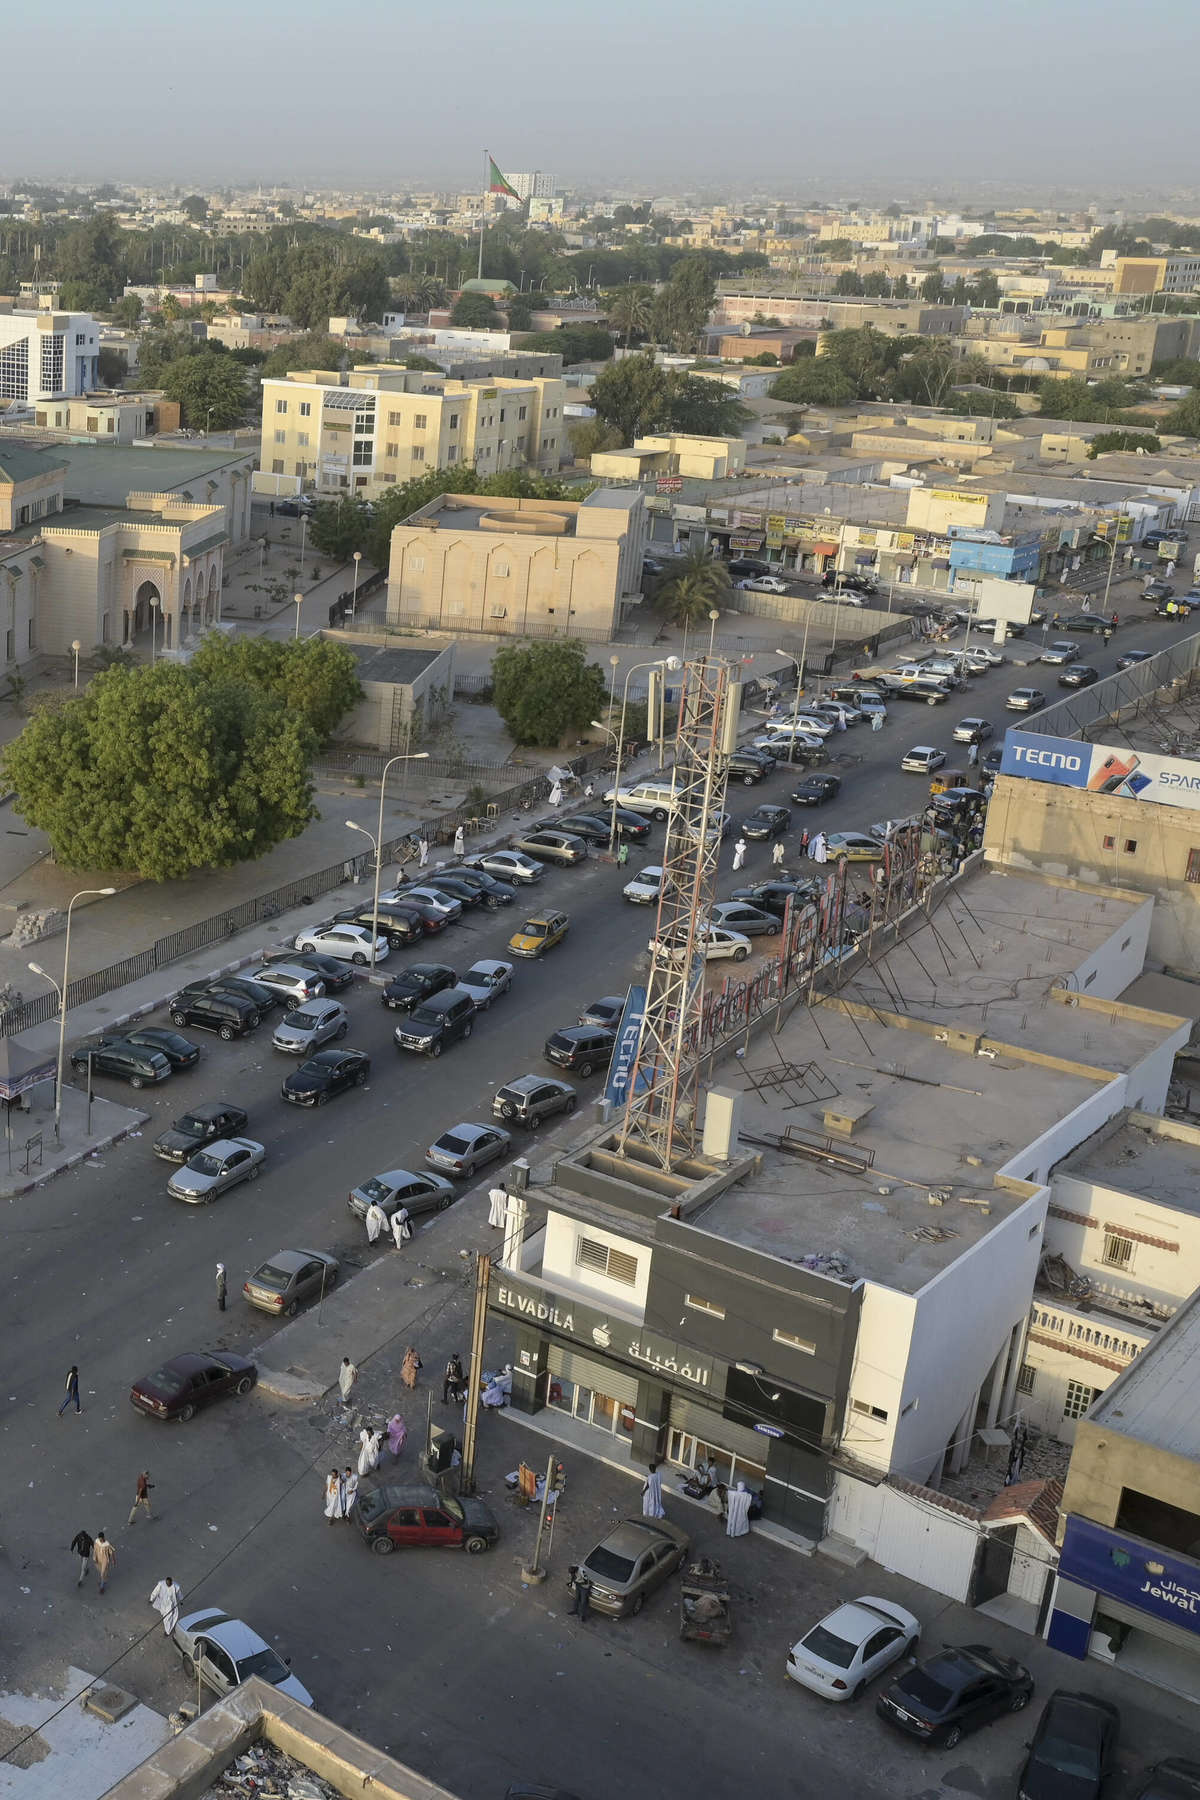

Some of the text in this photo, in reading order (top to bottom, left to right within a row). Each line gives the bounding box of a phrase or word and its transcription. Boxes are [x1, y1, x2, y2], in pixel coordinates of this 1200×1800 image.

[1012, 745, 1081, 771] TECNO
[498, 1287, 515, 1308] EL
[628, 1341, 708, 1386] الفضيلة
[1140, 1580, 1198, 1614] Jewal
